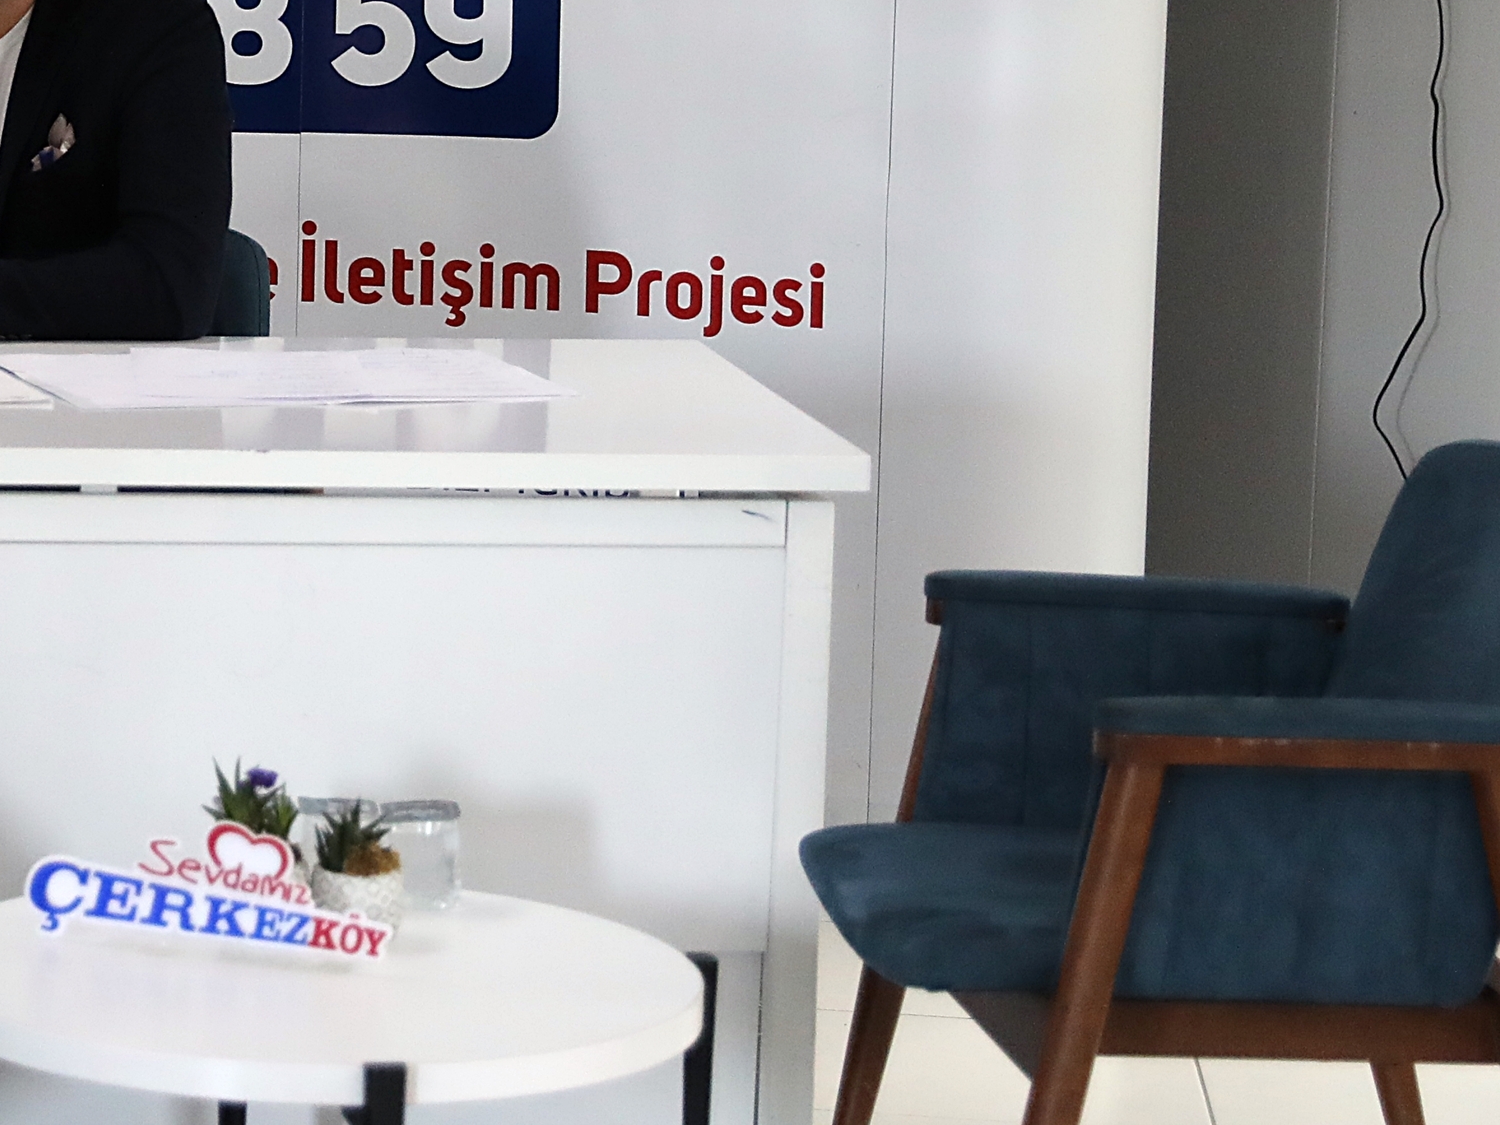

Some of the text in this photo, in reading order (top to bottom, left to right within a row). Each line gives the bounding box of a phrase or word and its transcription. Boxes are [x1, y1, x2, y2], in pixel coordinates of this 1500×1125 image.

[300, 219, 561, 328] İletişim
[584, 249, 827, 338] Projesi
[28, 859, 388, 959] ÇERKEZKÖY
[138, 839, 310, 907] Sevdamız
